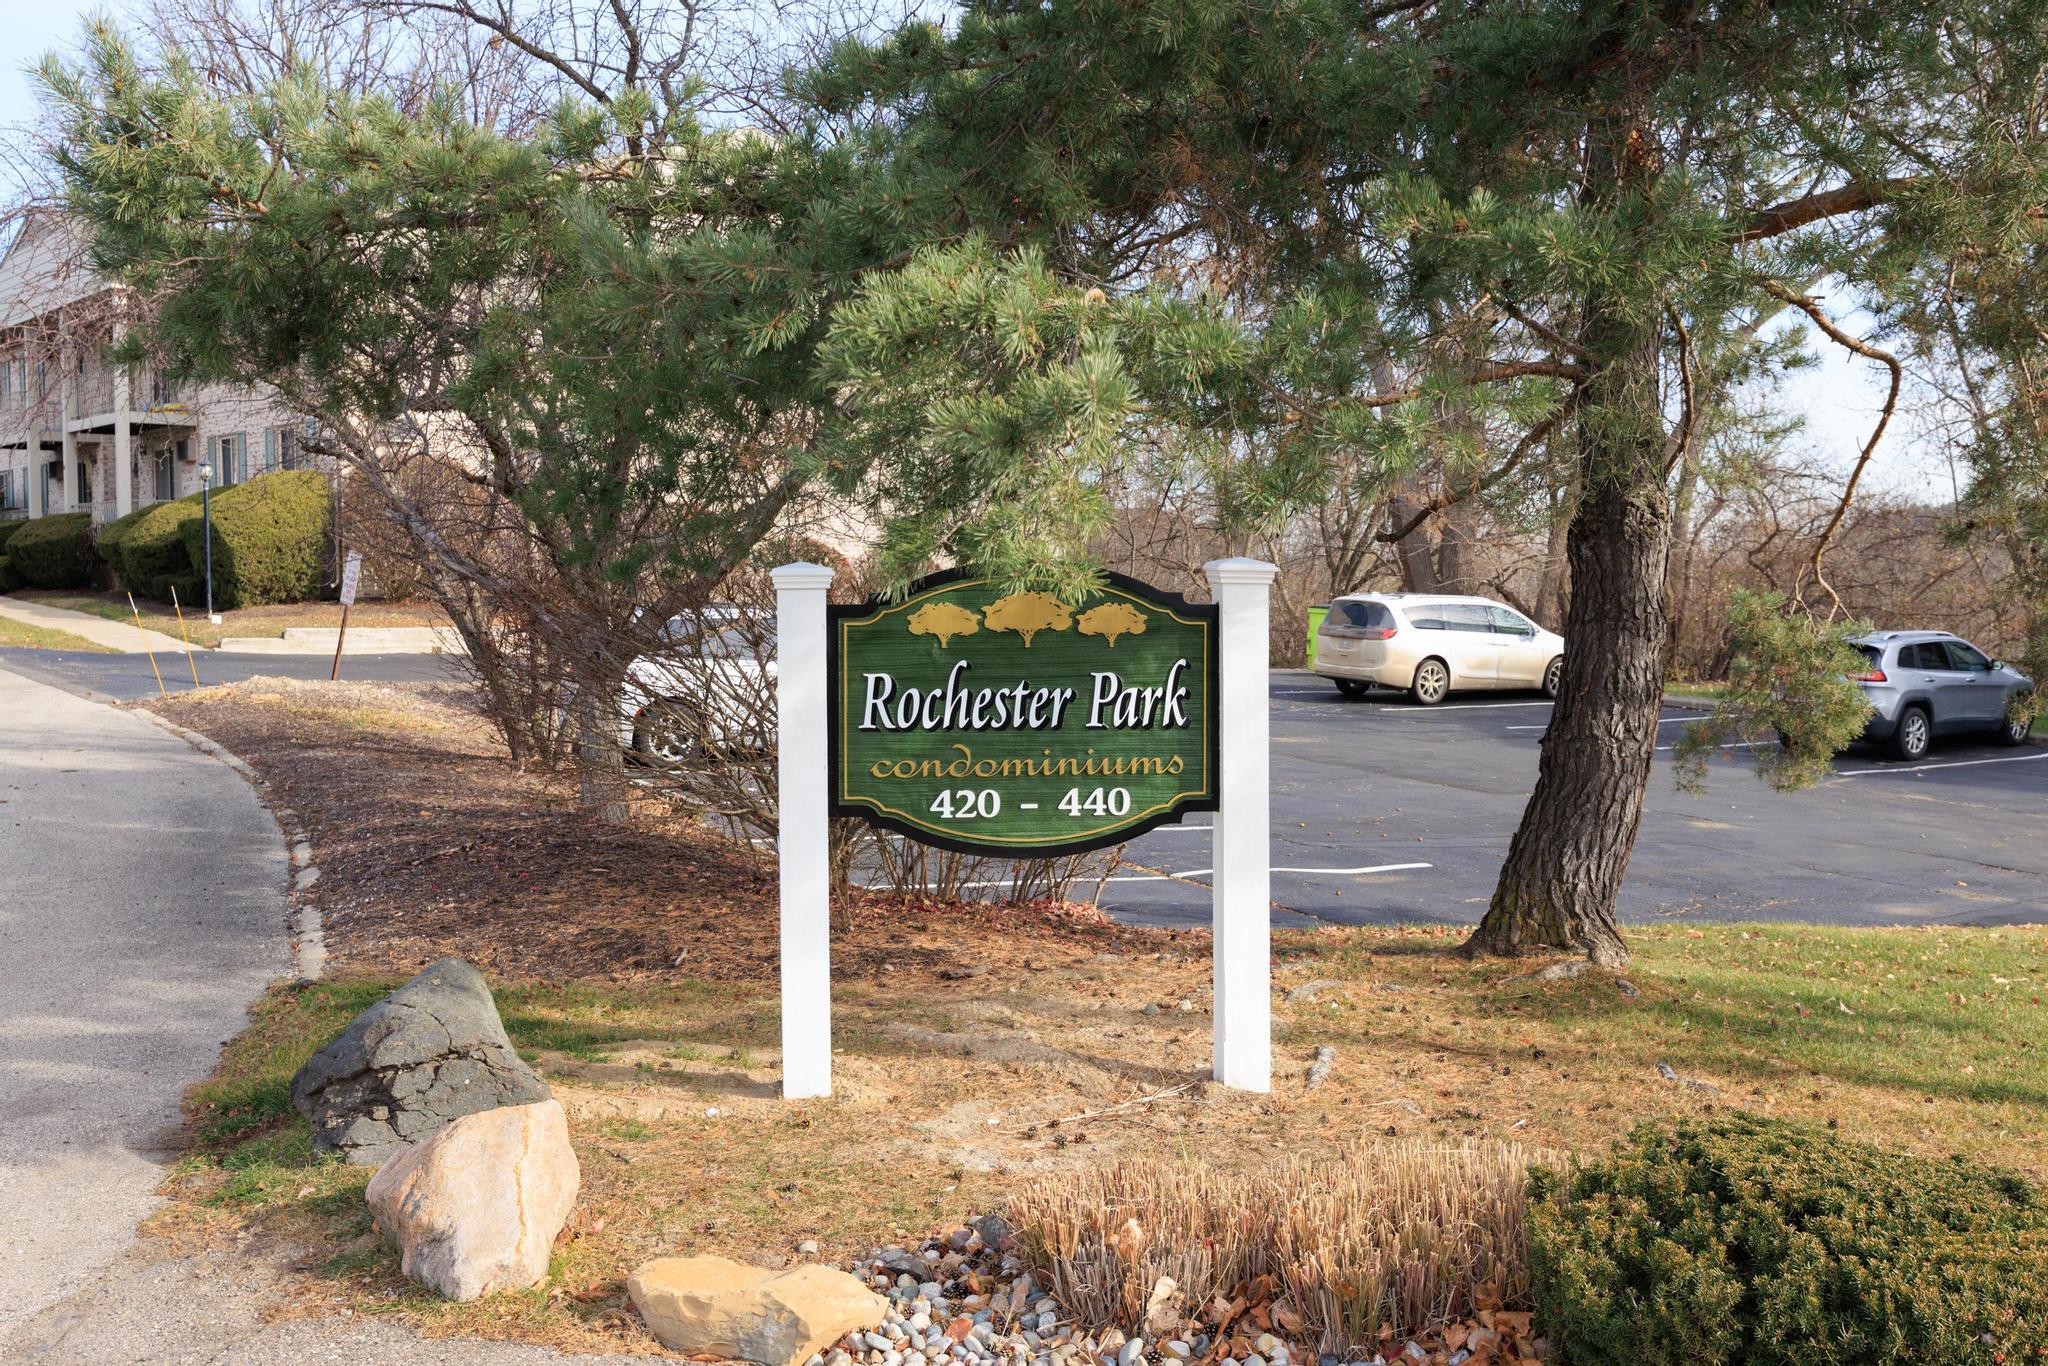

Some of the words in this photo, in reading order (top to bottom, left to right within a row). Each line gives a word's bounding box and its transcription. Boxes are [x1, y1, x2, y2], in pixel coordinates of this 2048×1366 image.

[858, 659, 1075, 731] Rochester
[1085, 658, 1189, 729] Park
[869, 743, 1185, 779] condominiums
[929, 789, 1002, 819] 420
[1057, 787, 1132, 817] 440
